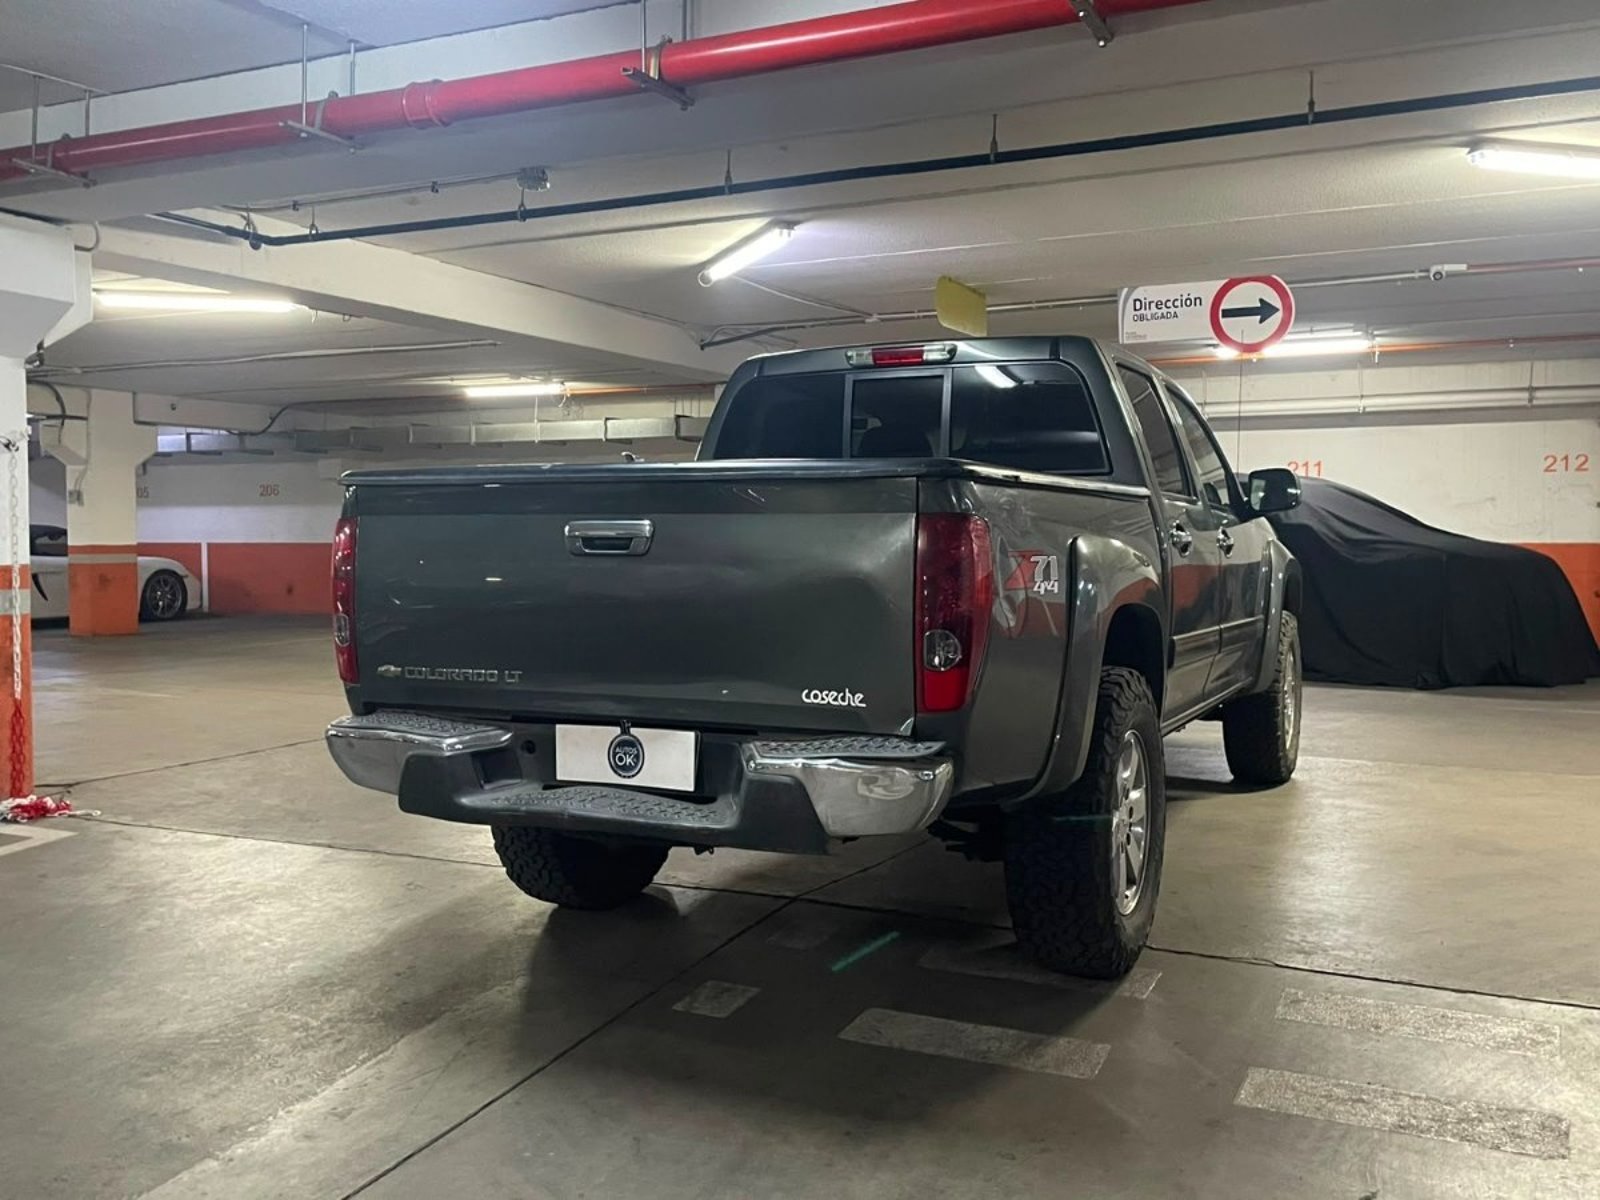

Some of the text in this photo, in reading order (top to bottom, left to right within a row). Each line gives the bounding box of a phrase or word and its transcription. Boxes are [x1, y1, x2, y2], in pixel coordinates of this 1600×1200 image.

[1133, 293, 1202, 312] Dirección
[1132, 311, 1179, 322] OBLIGADA
[1543, 453, 1589, 472] 212
[136, 487, 149, 498] 05
[259, 484, 280, 497] 206
[404, 666, 523, 683] COLORADO LT
[801, 687, 867, 707] coseche
[615, 753, 635, 766] OK
